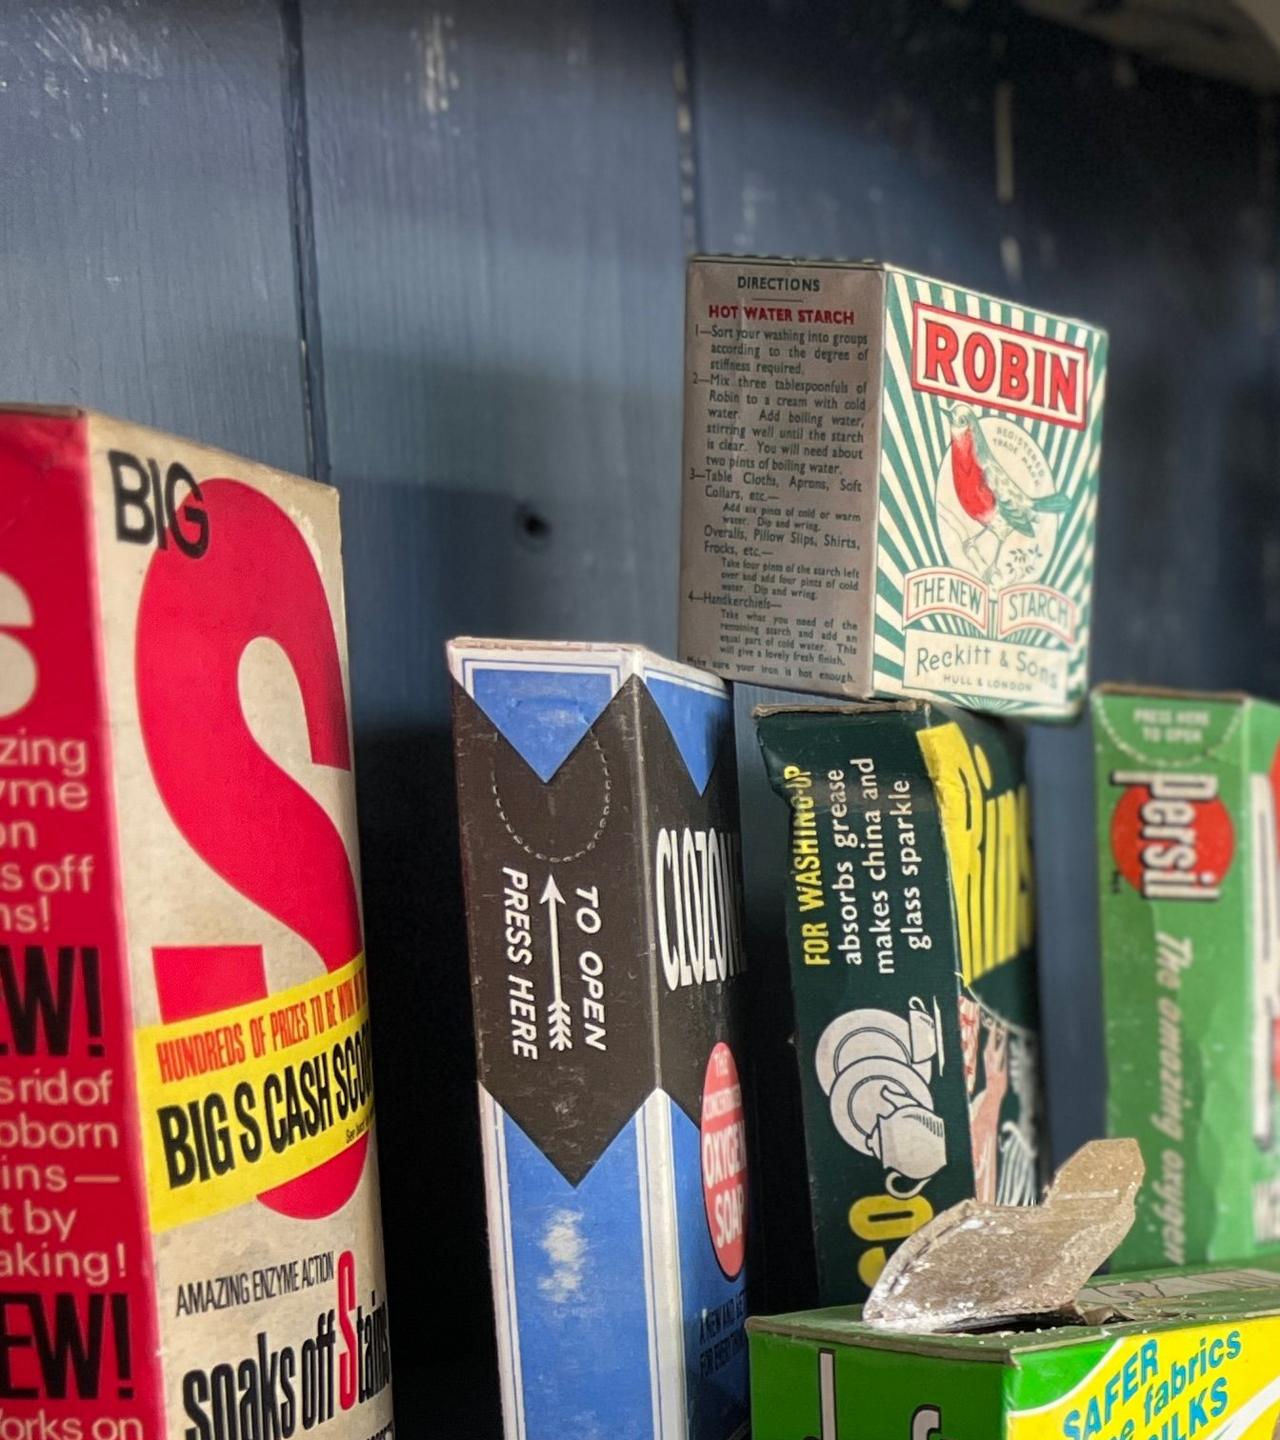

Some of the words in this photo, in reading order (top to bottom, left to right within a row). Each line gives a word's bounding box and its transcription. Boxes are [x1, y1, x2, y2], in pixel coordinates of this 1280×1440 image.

[738, 276, 820, 292] DIRECTIONS
[709, 305, 738, 319] HOT
[744, 307, 792, 322] WATER
[798, 310, 854, 324] STARCH
[736, 328, 760, 344] your
[764, 329, 804, 345] washing
[808, 331, 829, 343] into
[833, 335, 868, 347] groups
[711, 343, 760, 358] according
[815, 349, 849, 363] degree
[924, 320, 1078, 414] ROBIN
[709, 390, 739, 403] Robin
[777, 397, 807, 408] cream
[815, 396, 838, 408] with
[845, 398, 866, 411] cold
[739, 374, 767, 389] three
[775, 378, 848, 394] tablespoonfuls
[706, 423, 746, 439] stirring
[752, 425, 774, 438] well
[780, 427, 803, 439] until
[832, 429, 863, 443] starch
[789, 411, 822, 427] boiling
[729, 457, 755, 472] pints
[772, 459, 806, 475] boiling
[782, 442, 800, 456] will
[804, 445, 828, 457] need
[832, 445, 863, 460] about
[107, 449, 211, 560] BIG
[840, 478, 863, 493] Soft
[753, 526, 785, 543] Pillow
[912, 578, 946, 610] THE
[948, 583, 984, 617] NEW
[1007, 592, 1070, 629] STARCH
[916, 643, 992, 677] Reckitt
[1016, 651, 1060, 691] Sons
[986, 678, 1033, 693] LONDON
[849, 757, 880, 801] and
[827, 768, 859, 849] grease
[887, 779, 923, 877] sparkle
[133, 477, 375, 1221] S
[859, 808, 888, 882] china
[33, 853, 95, 893] off
[501, 866, 533, 966] PRESS
[575, 885, 603, 935] TO
[831, 860, 864, 966] absorbs
[867, 889, 896, 976] makes
[899, 885, 933, 951] glass
[801, 921, 832, 966] FOR
[1155, 931, 1194, 989] The
[507, 973, 539, 1062] HERE
[578, 950, 608, 1052] OPEN
[156, 1022, 247, 1086] HUNDREDS
[249, 1015, 267, 1060] OF
[269, 1001, 310, 1053] PRIZES
[1149, 1004, 1188, 1144] amazing
[156, 1091, 236, 1191] BIG
[233, 1080, 264, 1164] S
[263, 1051, 335, 1154] CASH
[24, 1200, 78, 1244] by
[714, 1183, 746, 1250] SOAP
[1148, 1151, 1188, 1266] oxygen
[0, 1242, 128, 1289] aking!
[176, 1270, 251, 1319] AMAZING
[252, 1260, 300, 1302] ENZYME
[301, 1250, 335, 1289] ACTION
[0, 1293, 134, 1399] EW!
[301, 1307, 337, 1431] off
[1143, 1330, 1242, 1428] fabrics
